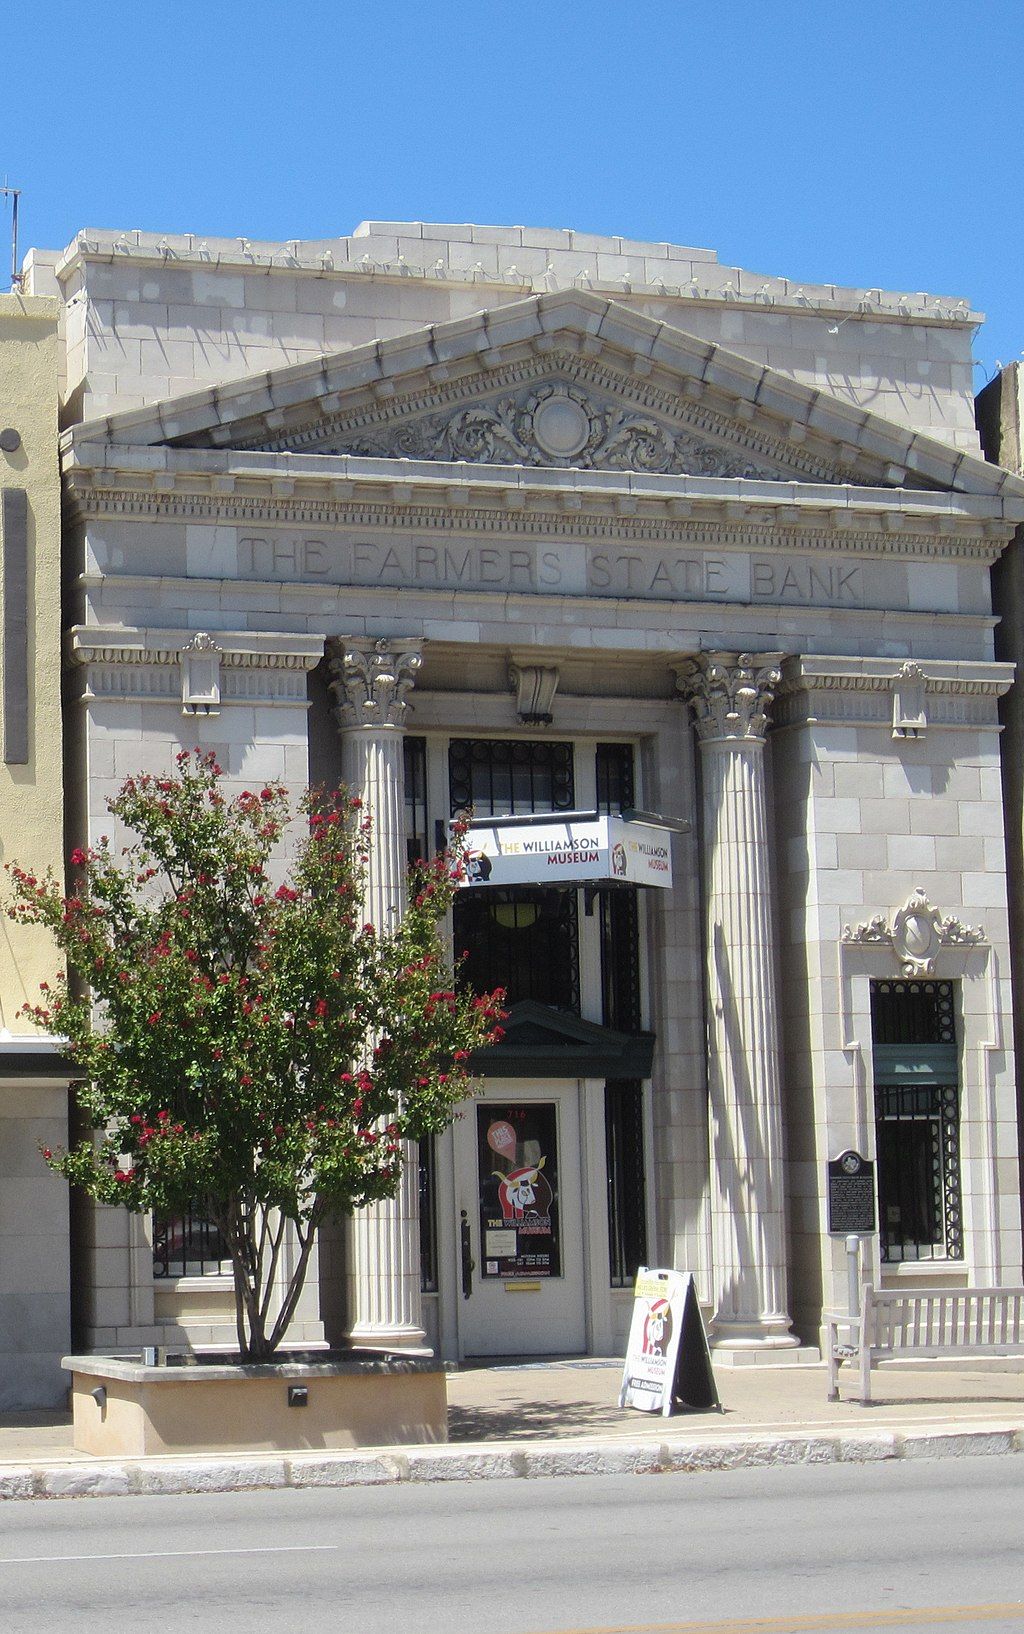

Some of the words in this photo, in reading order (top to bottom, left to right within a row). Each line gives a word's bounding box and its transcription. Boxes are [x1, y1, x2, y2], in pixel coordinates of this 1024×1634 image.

[238, 536, 332, 575] THE
[353, 542, 564, 585] FARMERS
[589, 555, 730, 595] STATE
[752, 562, 861, 600] BANK
[499, 842, 520, 854] THE
[523, 837, 600, 852] WILLIAMSON
[638, 842, 668, 859] WILLIAMSON
[547, 852, 600, 865] MUSEUM
[648, 859, 669, 872] MUSEUM
[492, 1125, 509, 1139] THIS
[487, 1219, 503, 1228] THE
